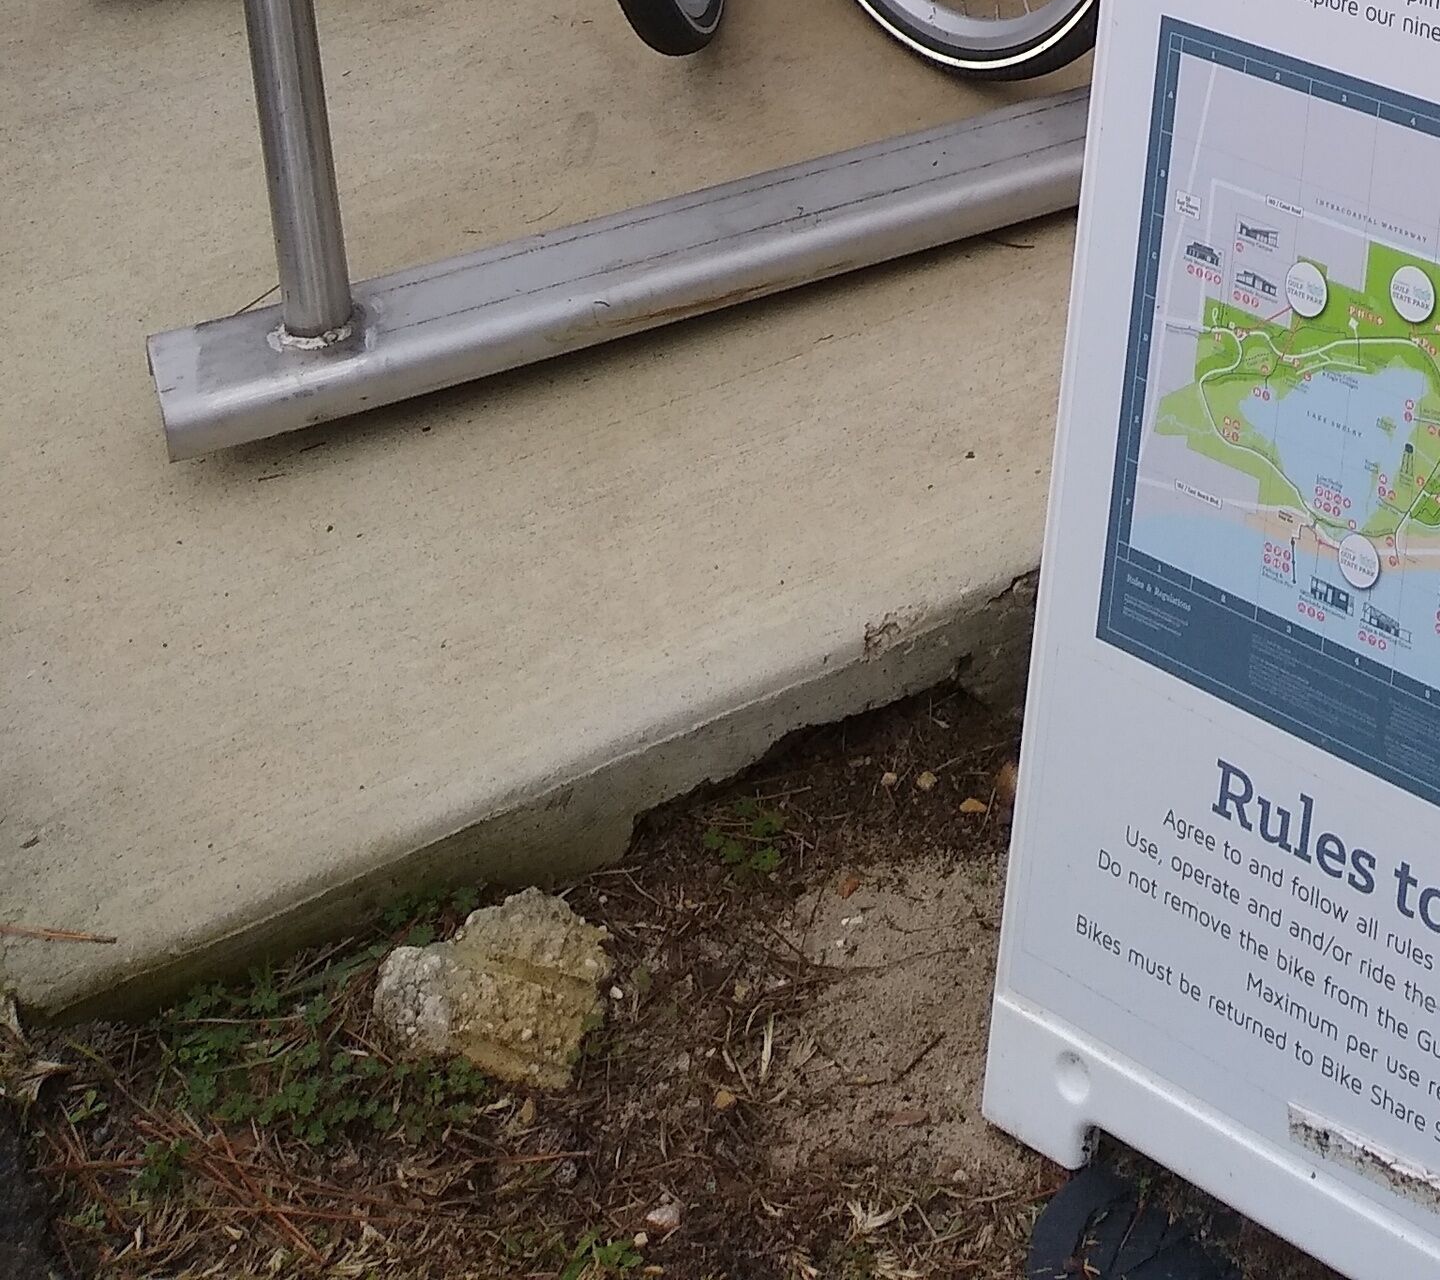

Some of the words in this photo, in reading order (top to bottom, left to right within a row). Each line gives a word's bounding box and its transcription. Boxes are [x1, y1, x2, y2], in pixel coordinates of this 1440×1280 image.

[1162, 808, 1216, 852] Agree
[1223, 839, 1242, 866] to
[1248, 857, 1284, 888] and
[1290, 875, 1350, 924] follow
[1355, 916, 1379, 942] all
[1386, 932, 1434, 971] rules
[1211, 757, 1377, 895] Rules
[1125, 824, 1163, 866] Use,
[1170, 855, 1241, 906] operate
[1247, 897, 1283, 928] and
[1288, 920, 1353, 967] and/or
[1359, 957, 1396, 992] ride
[1403, 979, 1438, 1014] the
